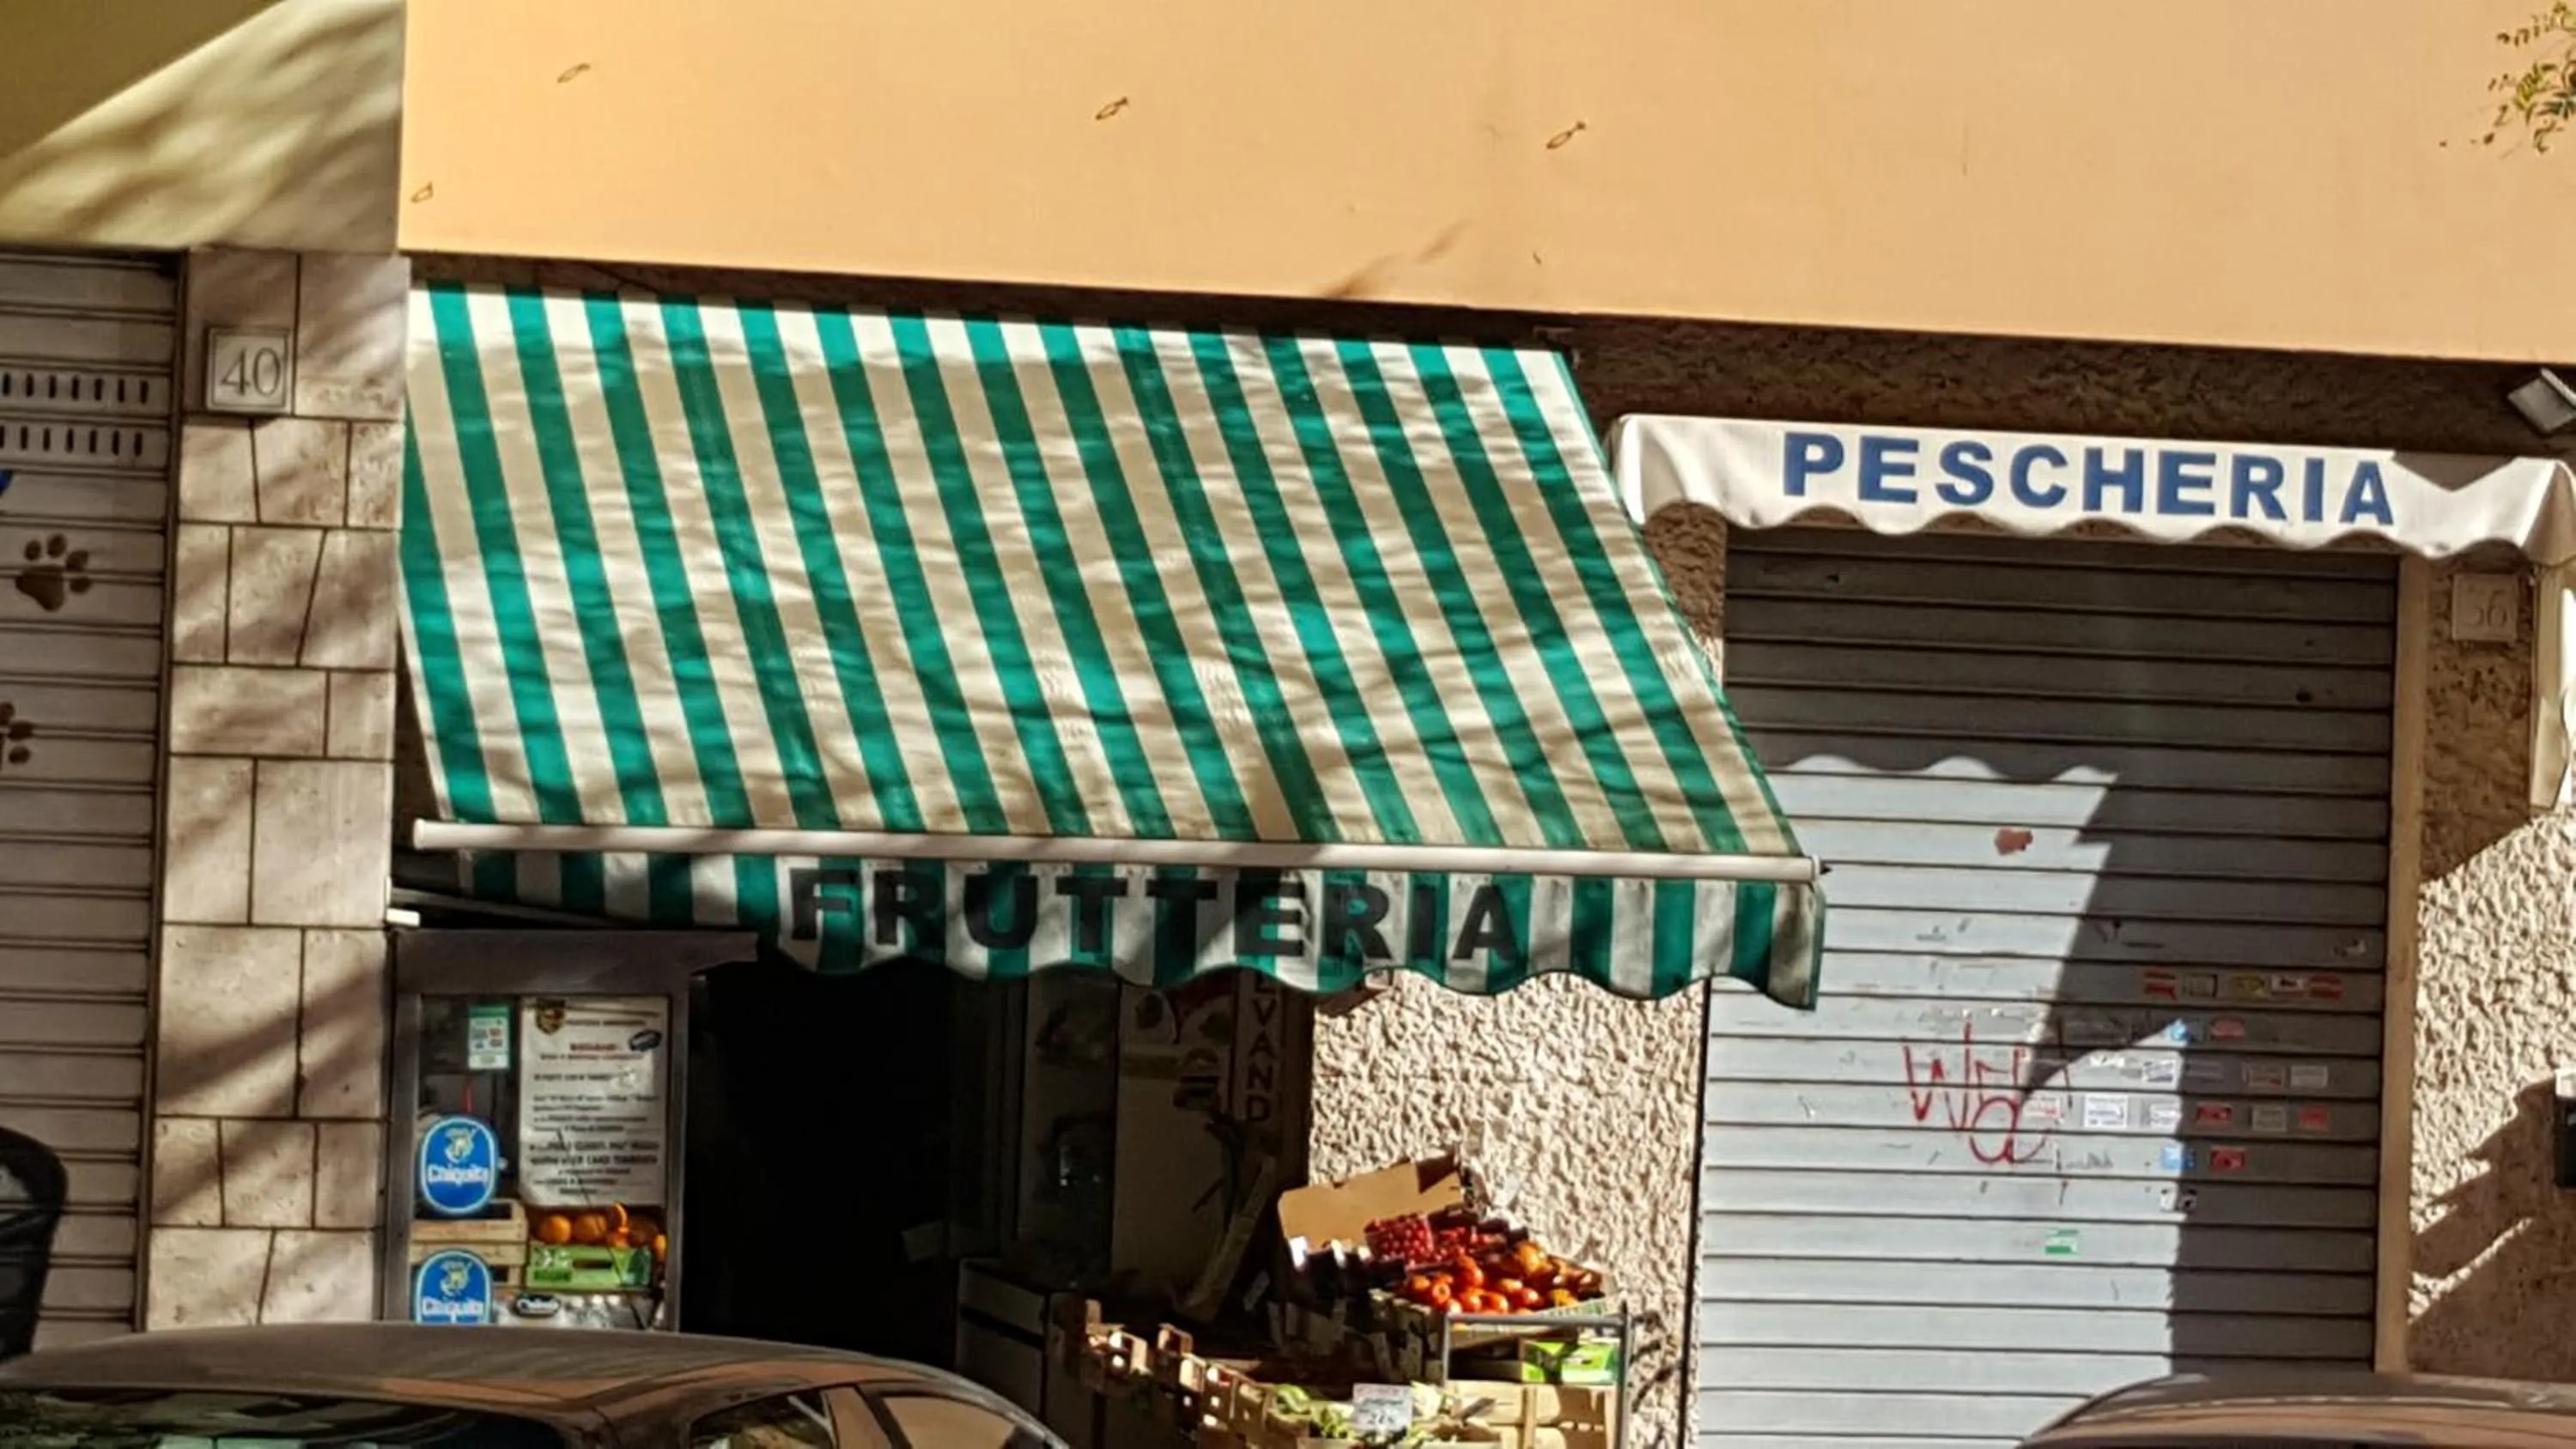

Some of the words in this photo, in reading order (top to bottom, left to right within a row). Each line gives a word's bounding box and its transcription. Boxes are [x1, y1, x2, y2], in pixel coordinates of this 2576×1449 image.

[221, 347, 281, 397] 40
[1783, 431, 2395, 525] PESCHERIA
[790, 866, 1517, 962] FRUTTERIA
